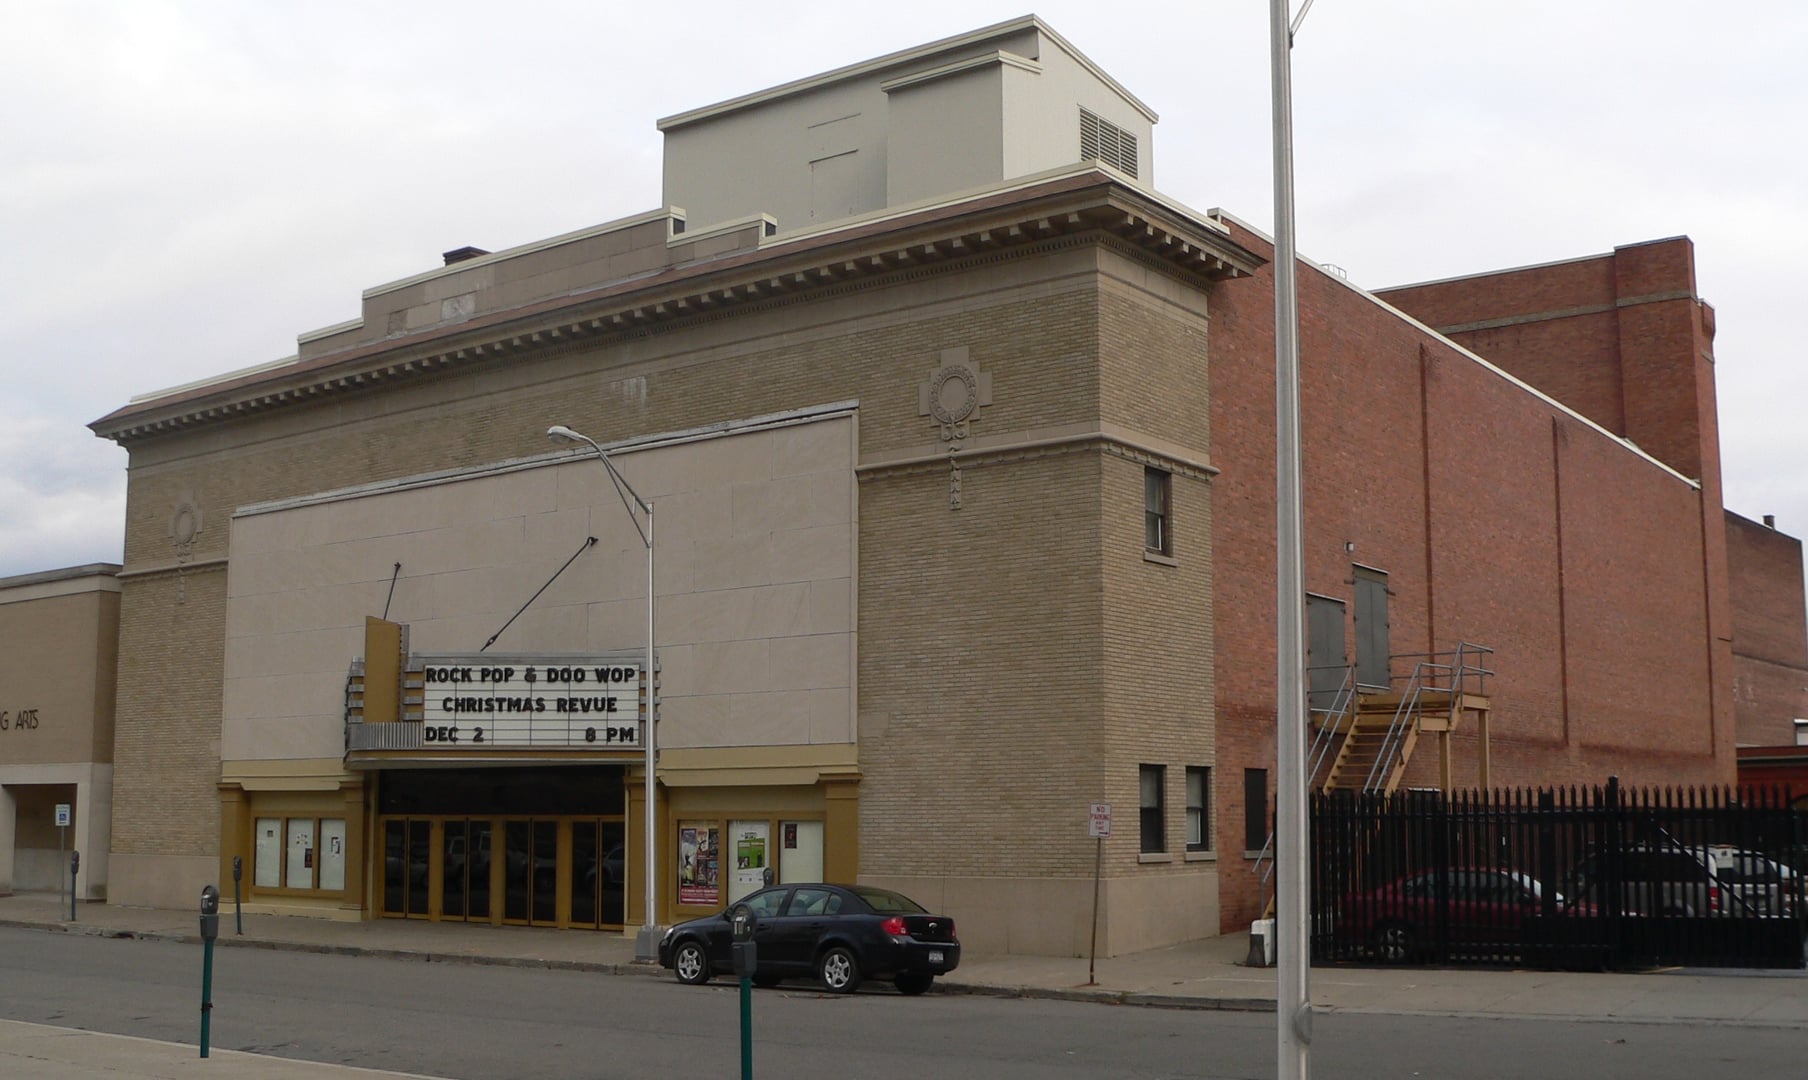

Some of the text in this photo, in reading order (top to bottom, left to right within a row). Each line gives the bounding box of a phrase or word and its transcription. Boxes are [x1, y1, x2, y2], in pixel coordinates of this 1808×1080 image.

[425, 667, 635, 683] ROCK POP & DOO WOP
[442, 697, 617, 713] CHRISTMAS REVUE
[0, 708, 39, 730] G ARTS
[425, 726, 634, 742] DEC 2 8 PM
